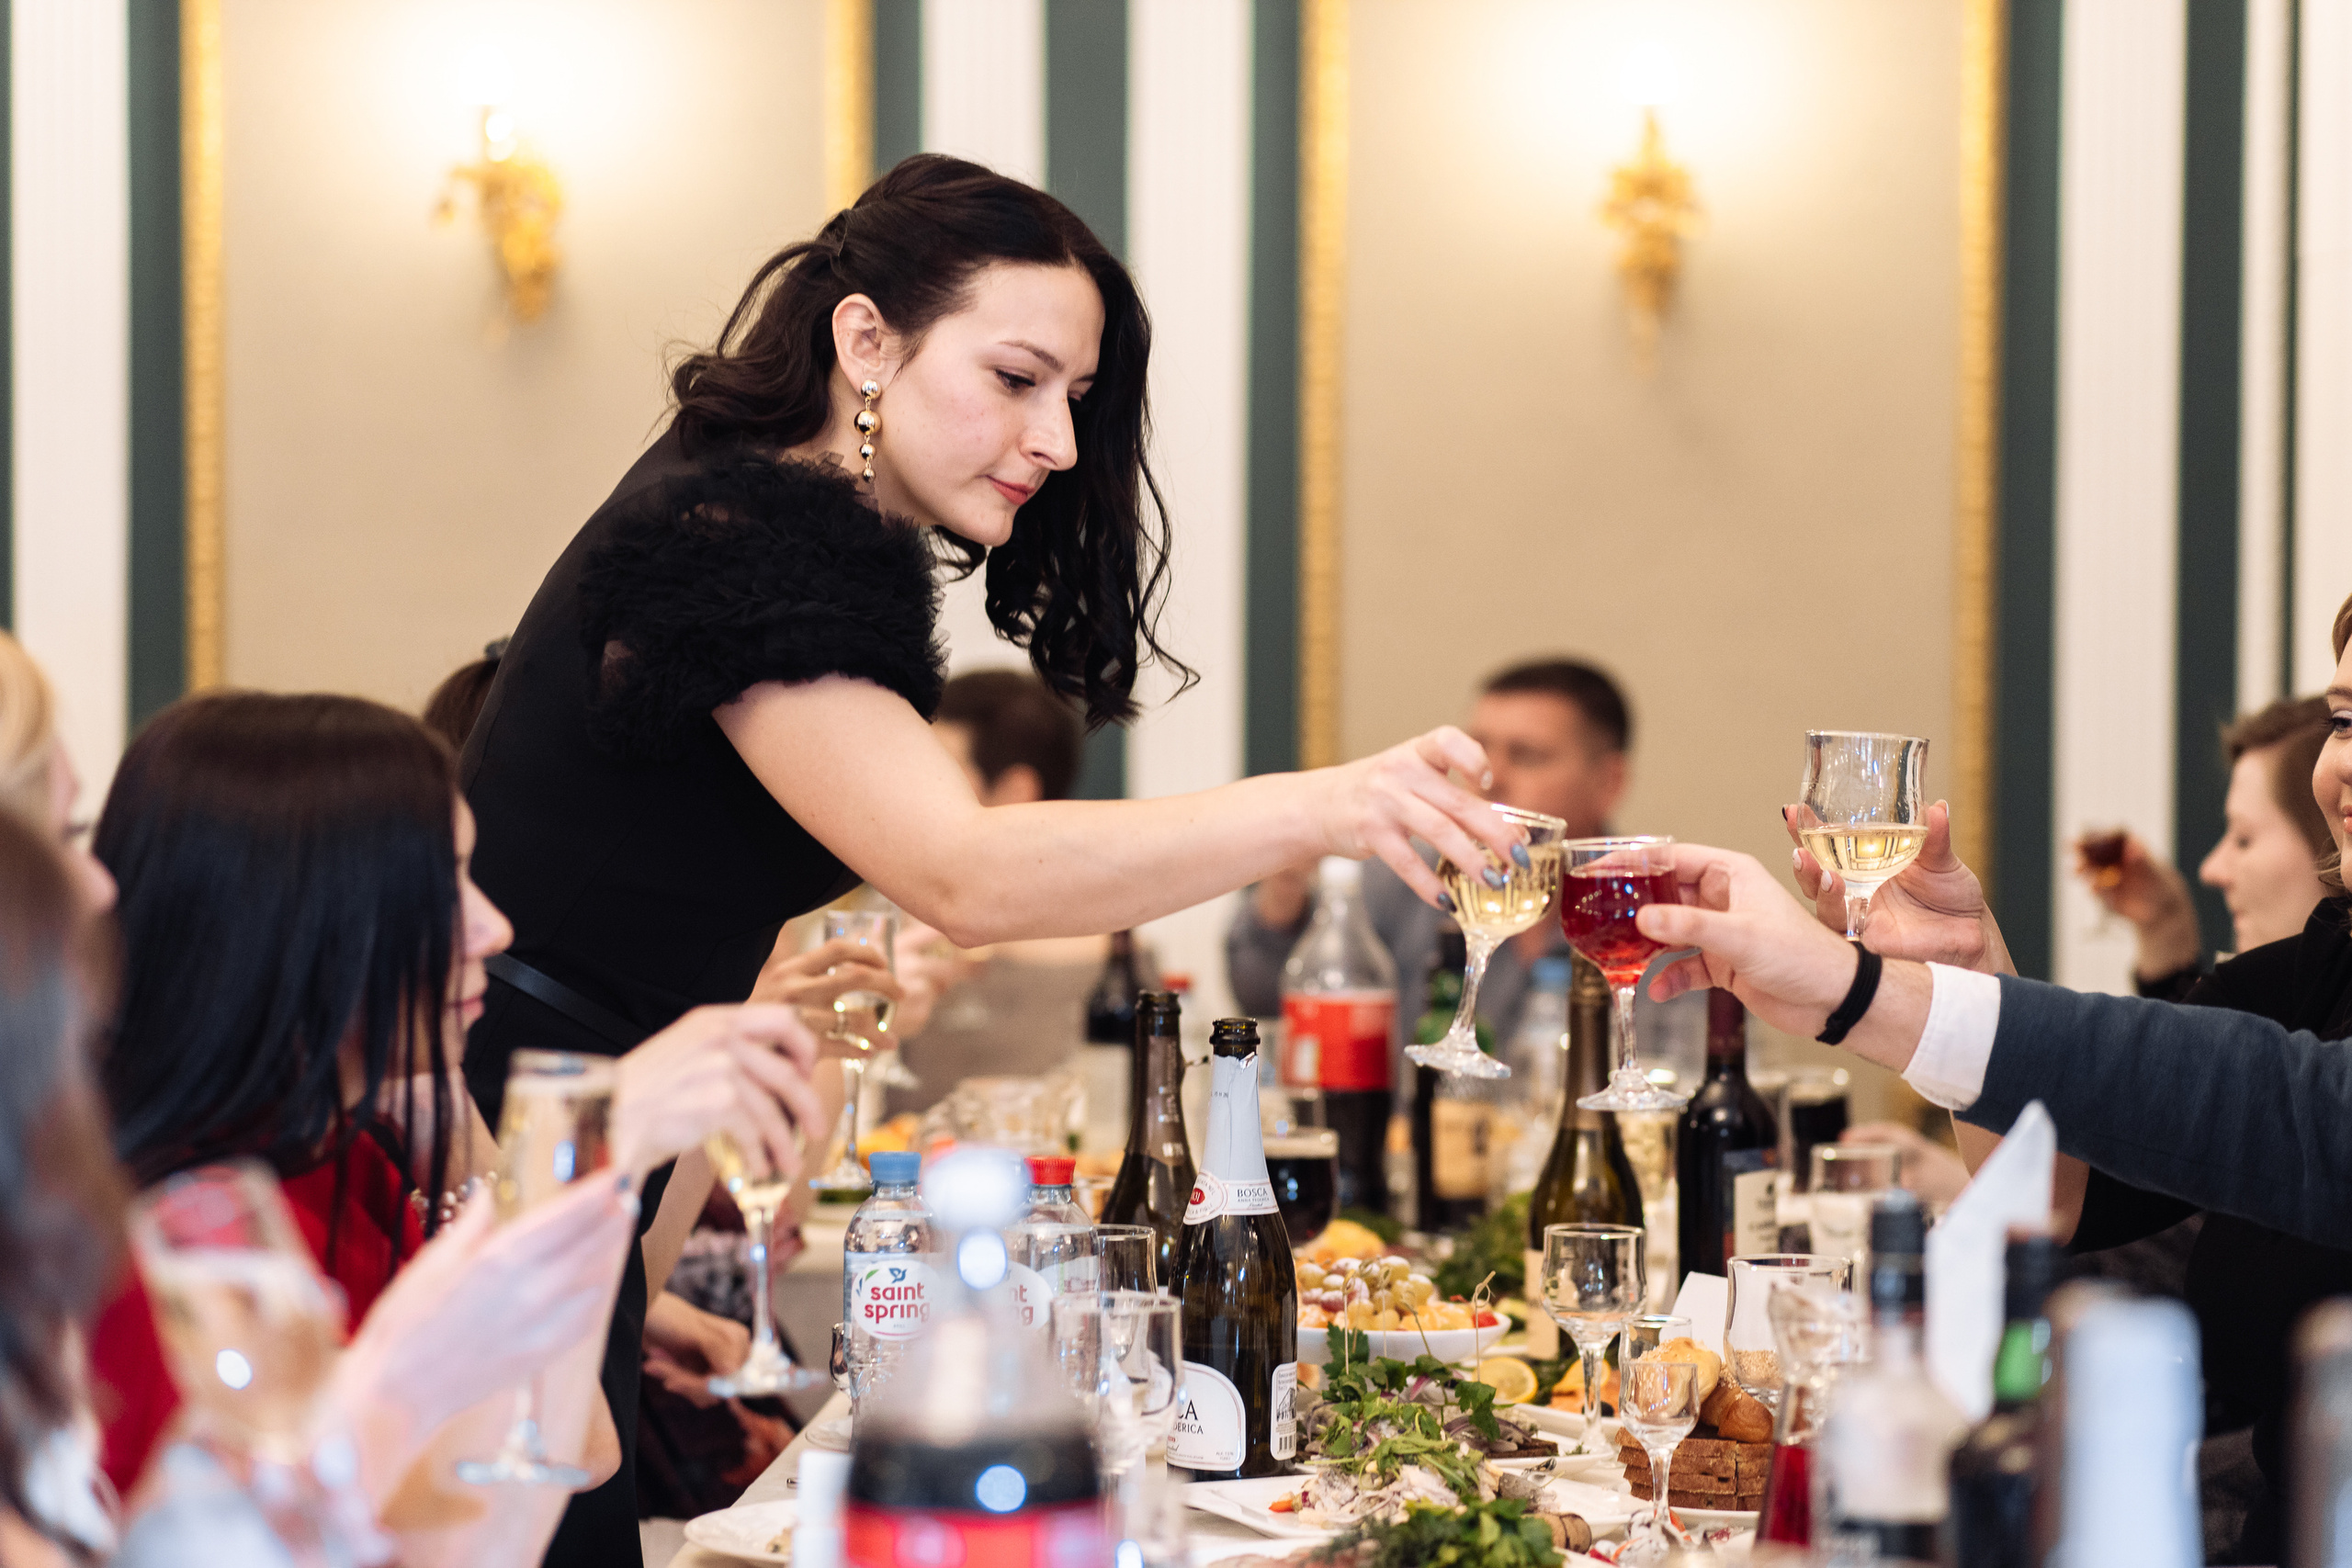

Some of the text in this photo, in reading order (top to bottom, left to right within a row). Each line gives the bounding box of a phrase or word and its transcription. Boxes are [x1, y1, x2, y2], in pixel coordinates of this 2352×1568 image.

[1237, 1187, 1268, 1198] BOSCA
[870, 1281, 925, 1301] saint
[865, 1302, 931, 1325] spring
